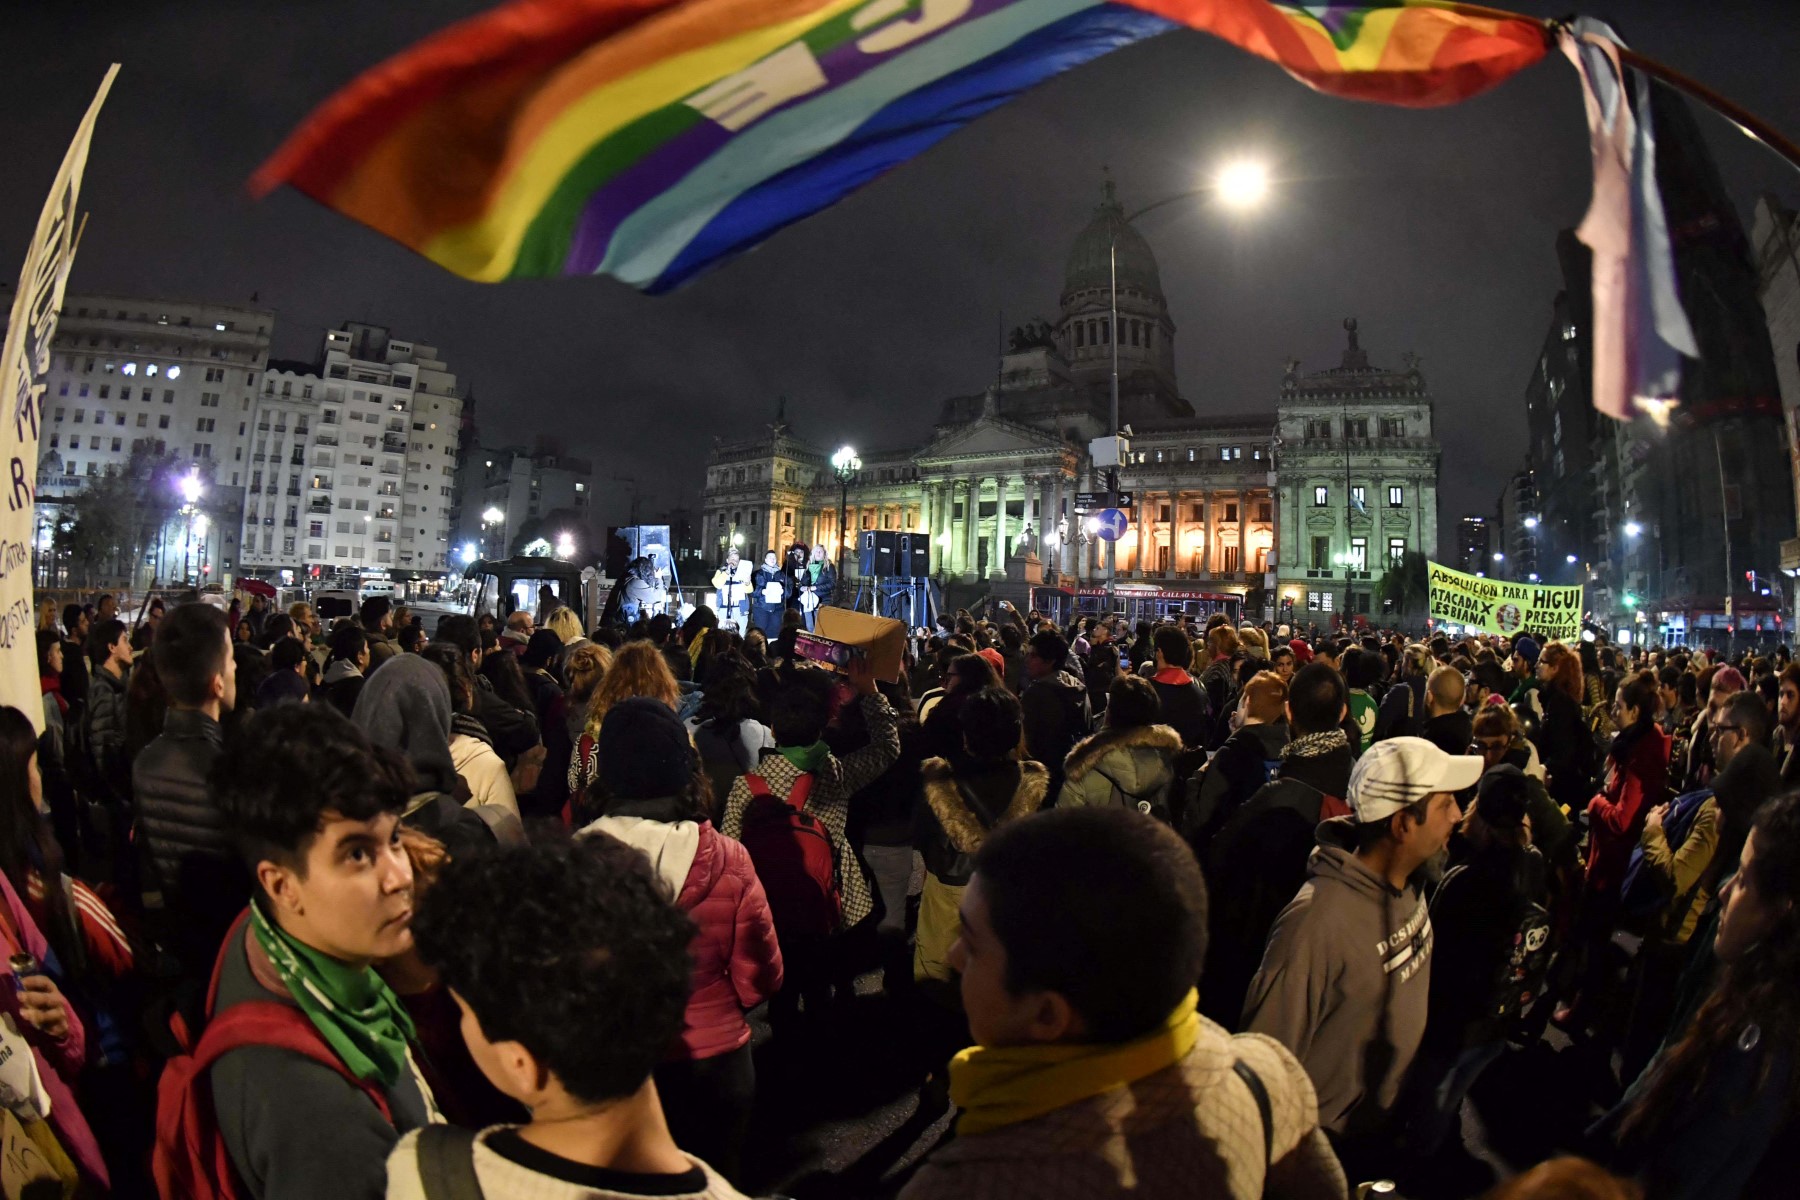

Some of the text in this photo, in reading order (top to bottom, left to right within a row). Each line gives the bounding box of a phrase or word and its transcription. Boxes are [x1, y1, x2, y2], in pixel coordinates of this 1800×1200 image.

[1430, 587, 1495, 615] ATACADA X
[1502, 586, 1529, 600] PARA
[1533, 589, 1580, 609] HIGUI
[1430, 602, 1486, 627] ESBIANA
[1525, 610, 1577, 625] PRESA X
[1523, 624, 1577, 639] DEFENDERSE
